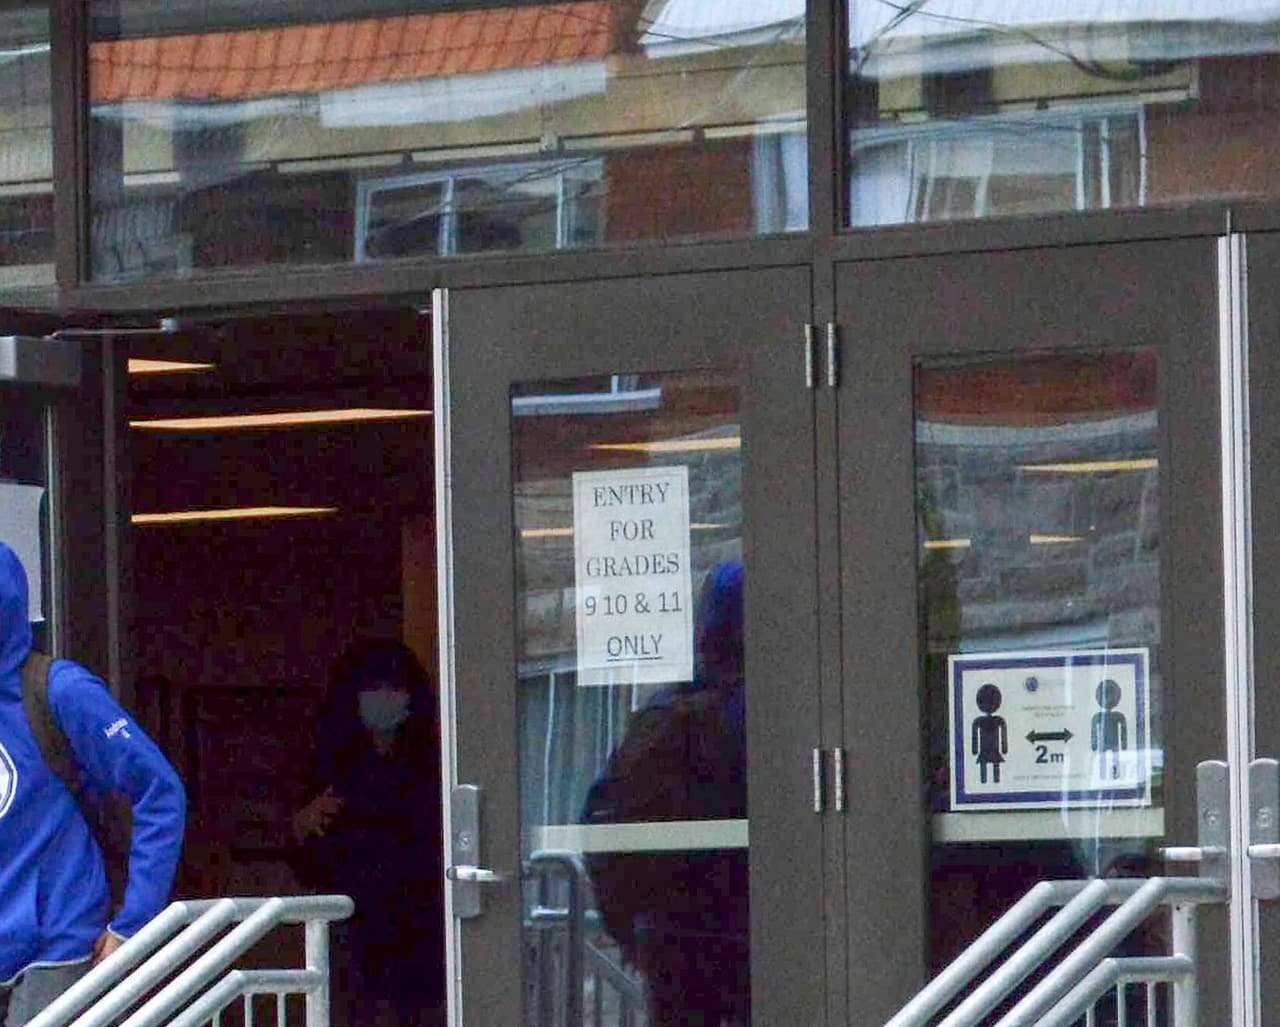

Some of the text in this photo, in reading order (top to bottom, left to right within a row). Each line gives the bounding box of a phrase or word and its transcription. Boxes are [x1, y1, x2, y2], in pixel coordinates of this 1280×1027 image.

[593, 482, 670, 507] ENTRY
[609, 519, 655, 541] FOR
[586, 553, 679, 577] GRADES
[585, 592, 682, 616] 9 10 & 11
[607, 634, 663, 657] ONLY
